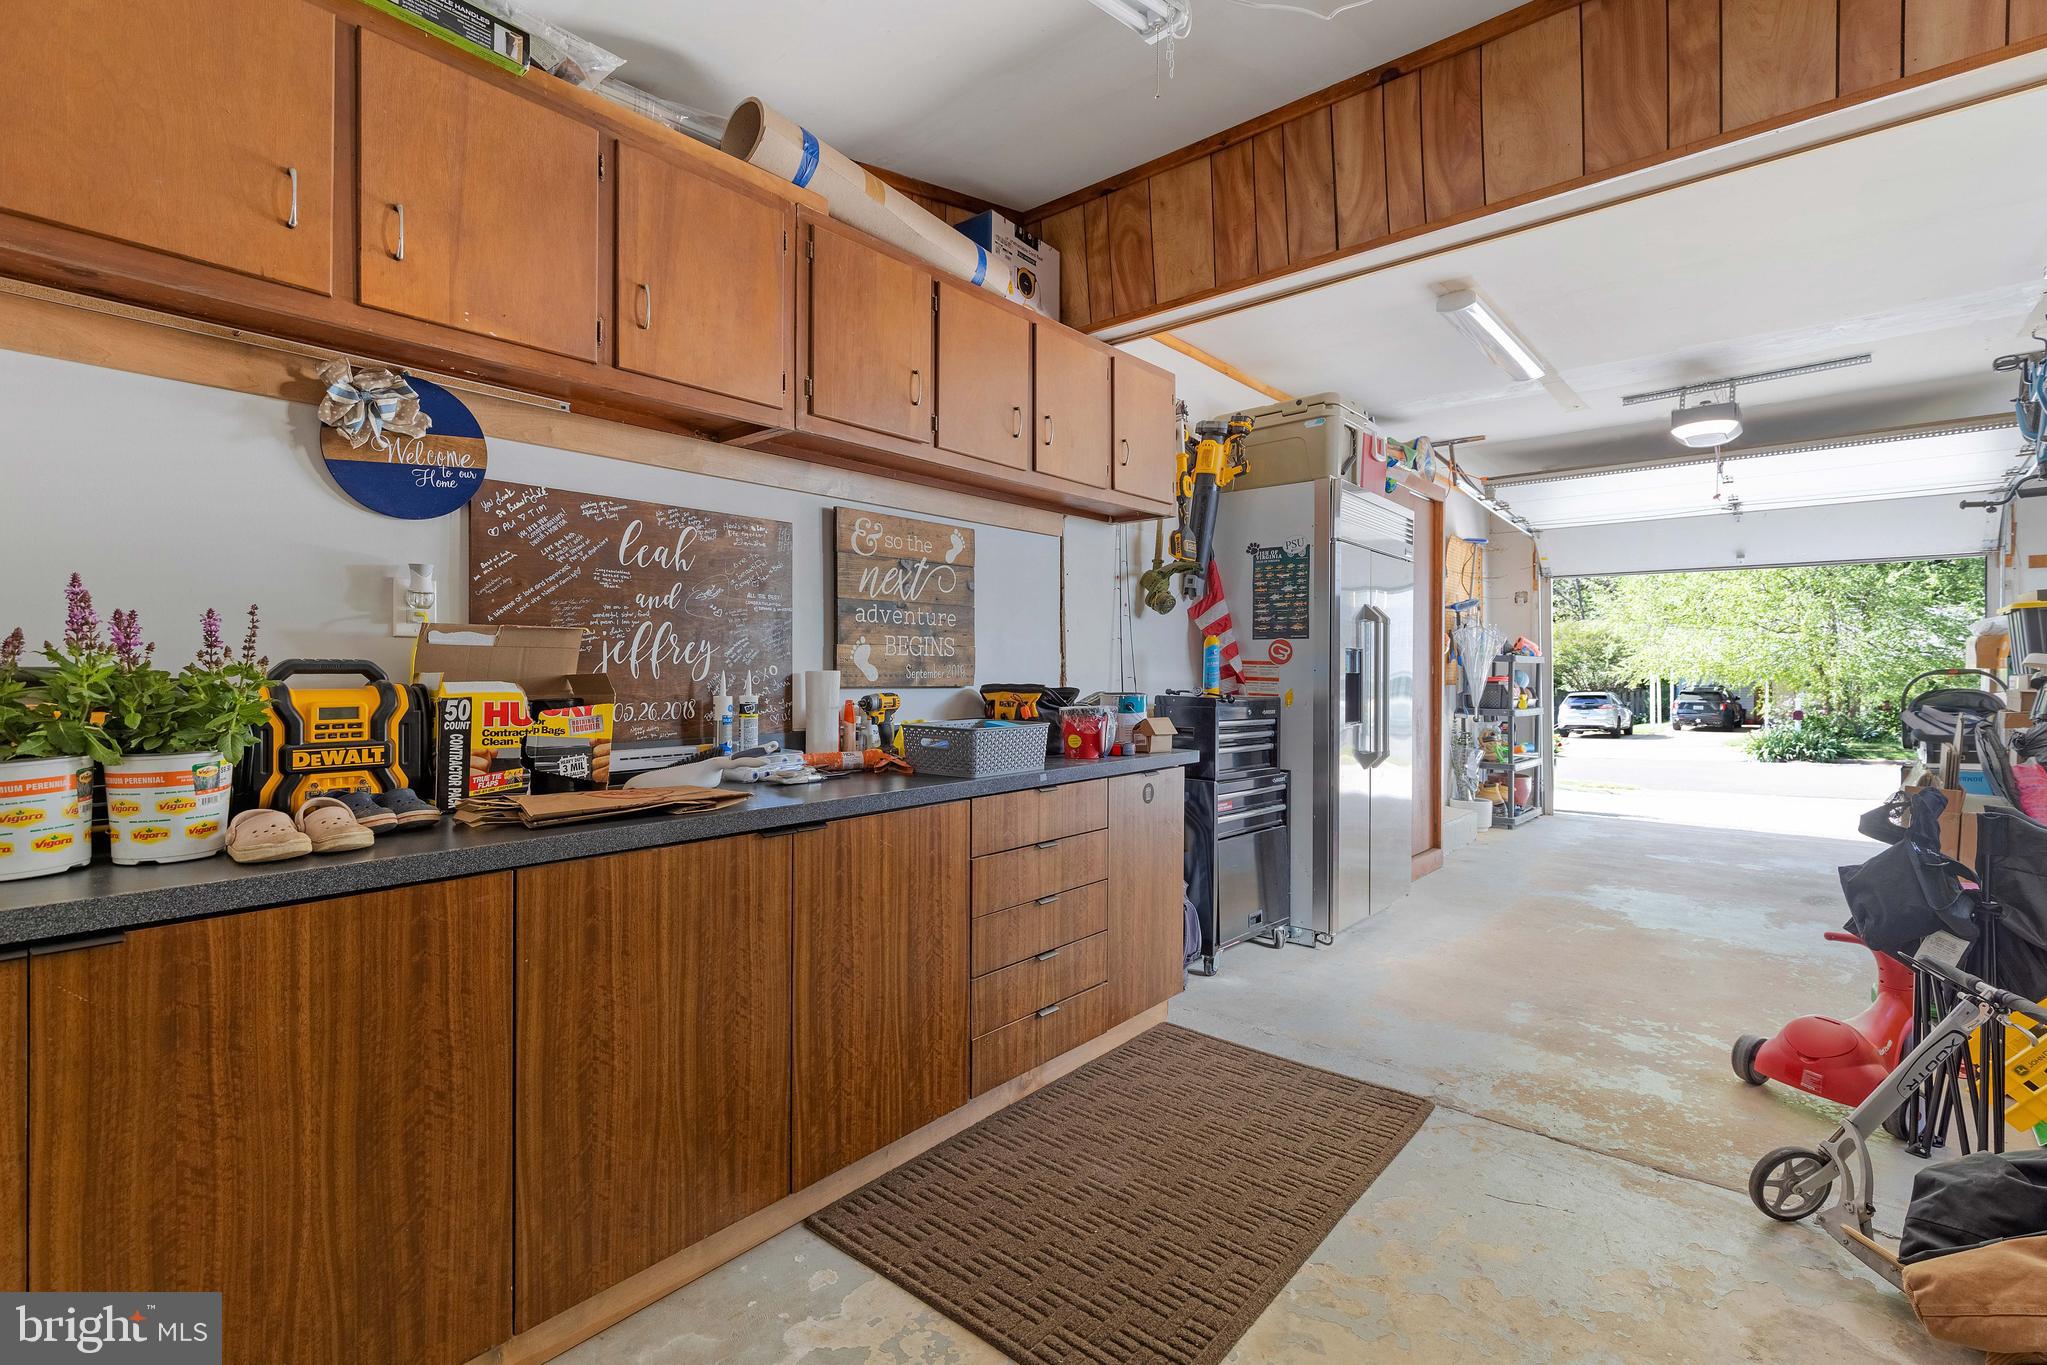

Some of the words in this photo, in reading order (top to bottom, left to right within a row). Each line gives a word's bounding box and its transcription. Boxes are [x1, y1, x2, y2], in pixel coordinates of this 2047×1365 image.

[454, 2, 491, 25] HANDLES
[371, 436, 476, 469] Welcome
[411, 468, 458, 489] Home
[441, 465, 453, 478] to
[459, 470, 477, 480] our
[618, 519, 696, 572] leah
[850, 517, 884, 556] &
[884, 535, 903, 549] so
[906, 535, 933, 553] the
[1285, 537, 1305, 550] PSU
[858, 556, 957, 600] next
[635, 582, 682, 610] and
[855, 603, 957, 627] adventure
[592, 620, 720, 682] jeffrey
[884, 634, 956, 658] BEGINS
[905, 664, 945, 683] September
[444, 698, 471, 721] 50
[612, 698, 697, 722] 05.26.2018
[444, 721, 471, 730] COUNT
[541, 726, 566, 736] Bags
[292, 748, 385, 768] DEWALT
[448, 733, 464, 786] CONTRACTOR
[562, 764, 568, 773] 3
[570, 762, 586, 772] MIL
[26, 780, 70, 791] PERENNIAL
[124, 776, 166, 785] PERENNIAL
[477, 779, 499, 790] FLAPS
[111, 804, 139, 813] Vigoro
[159, 802, 197, 811] Vigoro
[0, 812, 44, 824] Vigoro
[133, 831, 169, 841] Vigoro
[189, 824, 218, 835] Vigoro
[35, 837, 73, 849] Vigoro
[1906, 1038, 1960, 1091] XOOTR
